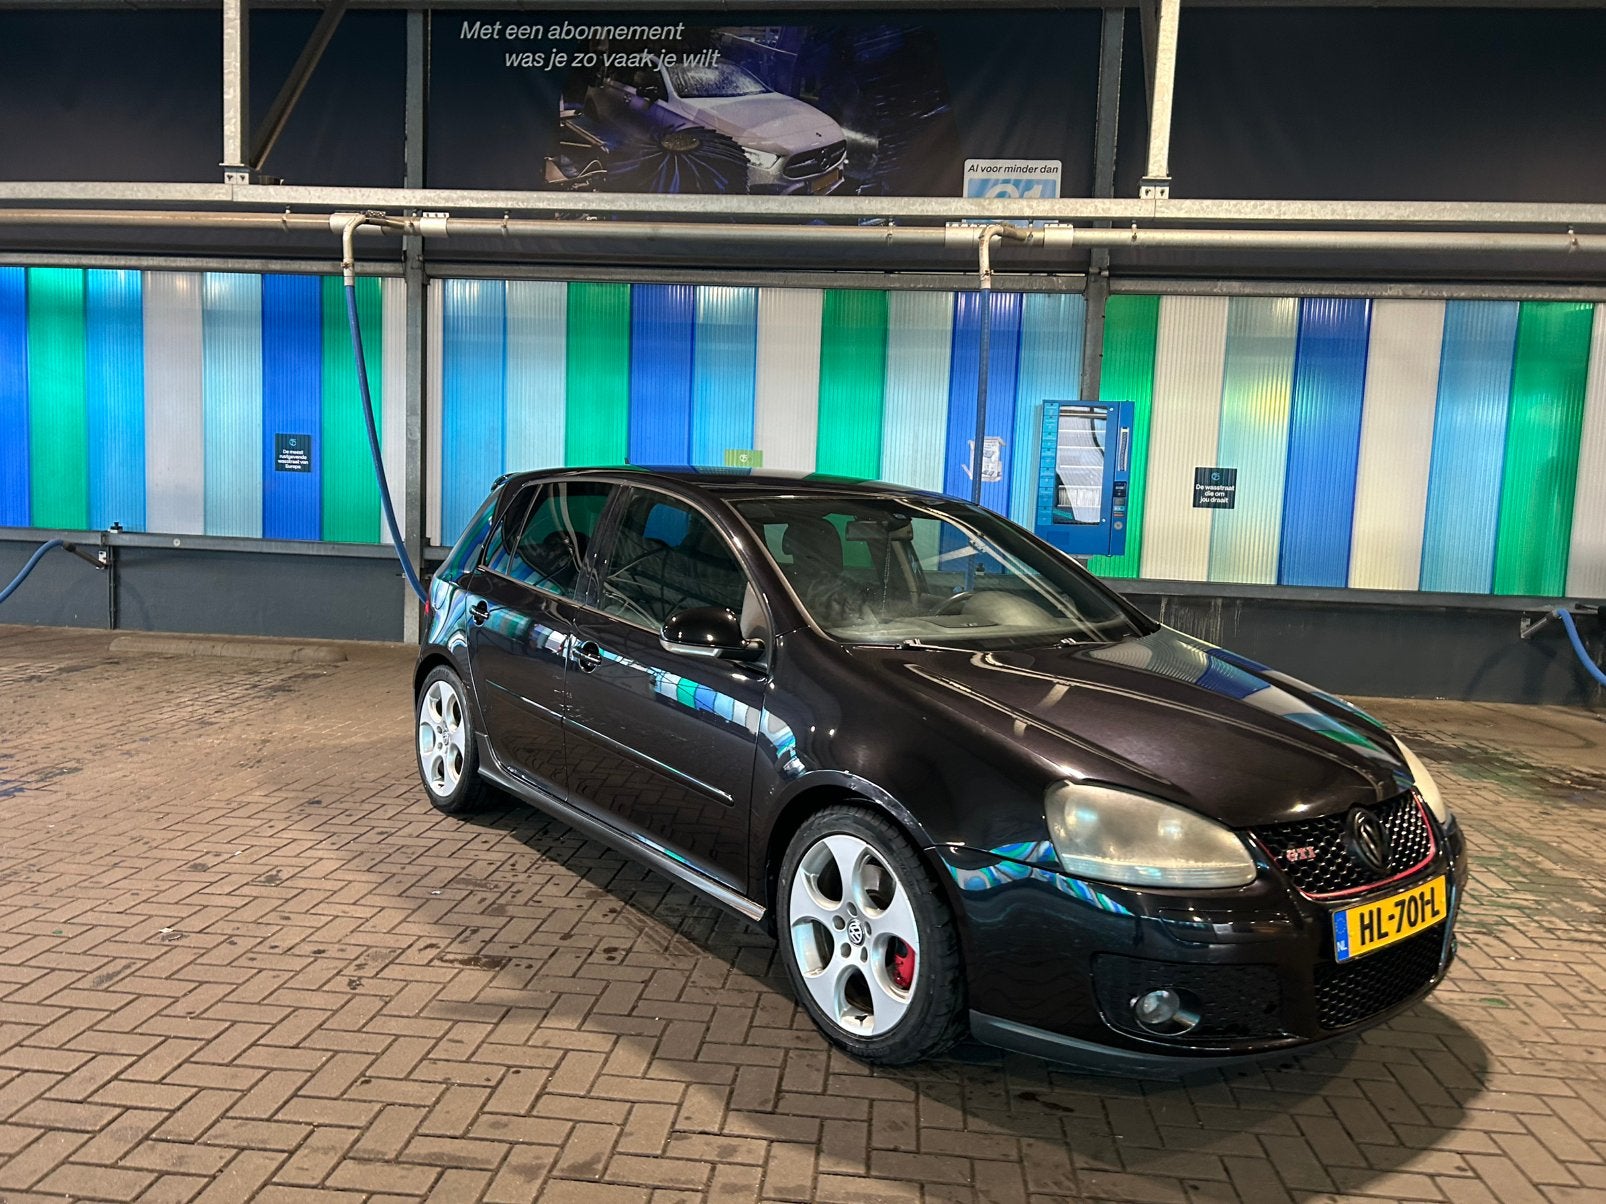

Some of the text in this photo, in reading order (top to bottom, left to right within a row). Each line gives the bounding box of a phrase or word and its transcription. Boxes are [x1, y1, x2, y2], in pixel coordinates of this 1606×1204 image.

[460, 21, 685, 40] Met een abonnement
[505, 49, 721, 72] was je zo vaak je wilt
[968, 164, 1059, 174] Al voor minder dan
[1199, 496, 1229, 504] jou draait
[1286, 846, 1317, 862] GTI
[1336, 940, 1348, 952] NL
